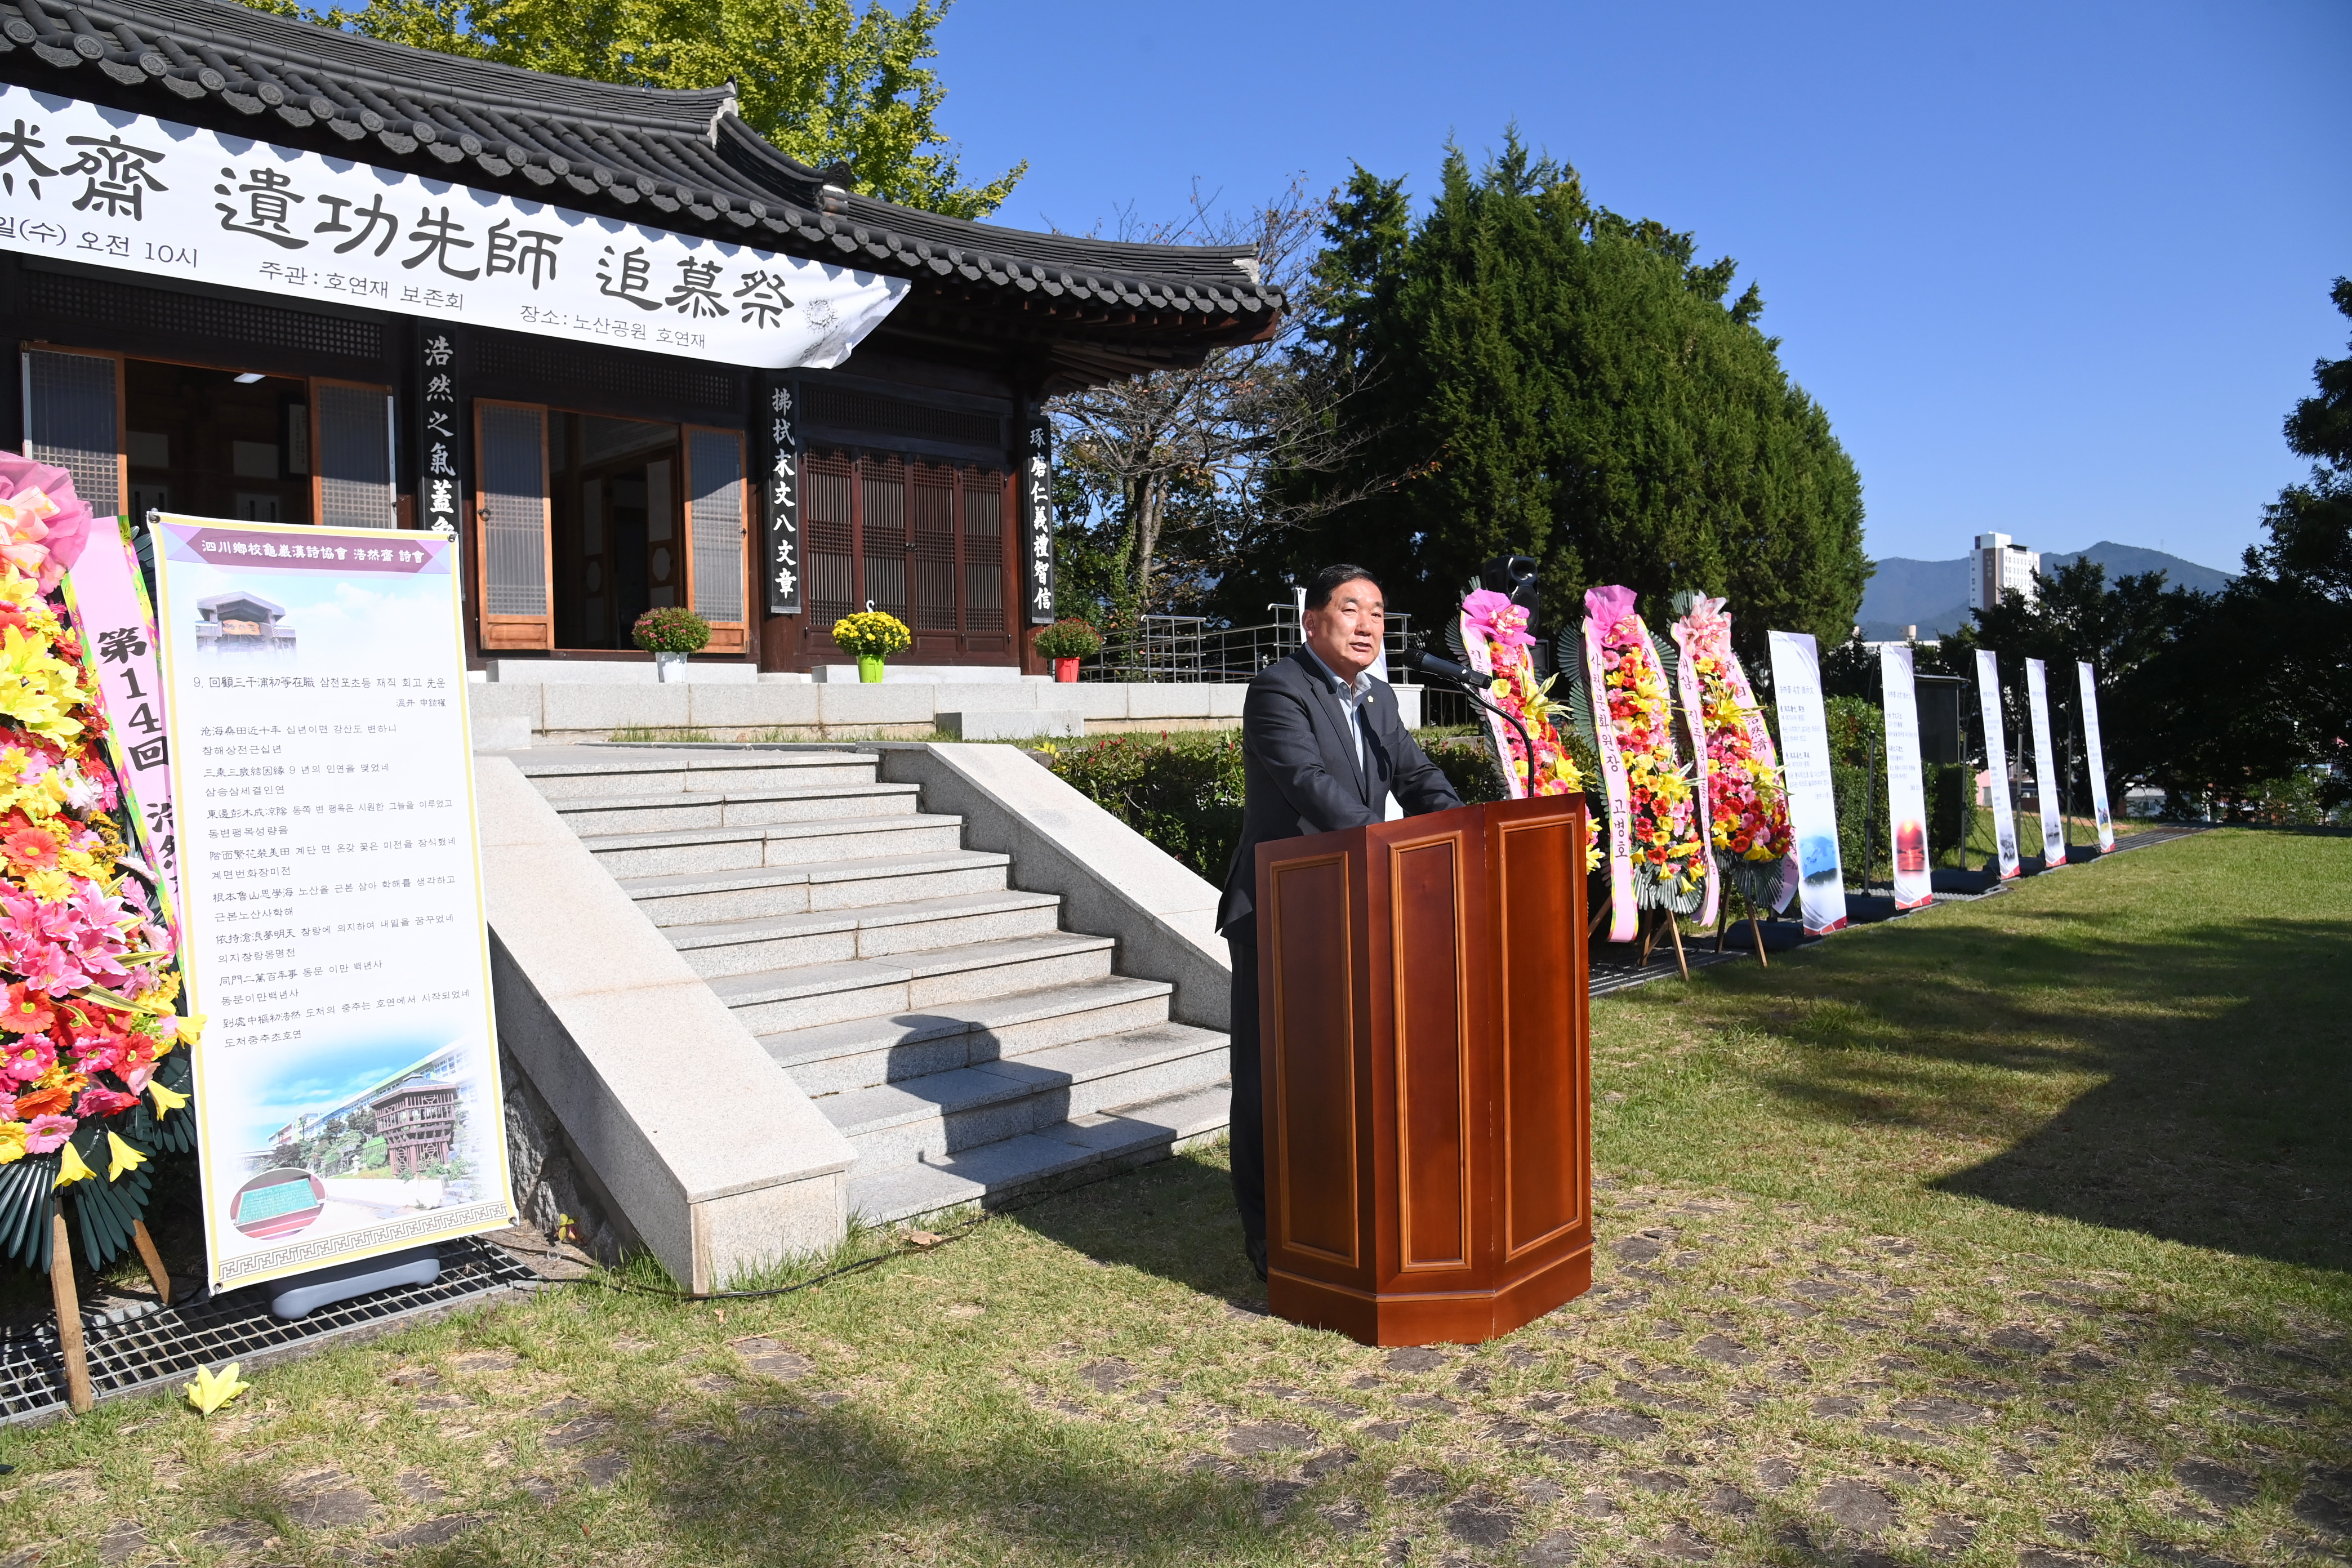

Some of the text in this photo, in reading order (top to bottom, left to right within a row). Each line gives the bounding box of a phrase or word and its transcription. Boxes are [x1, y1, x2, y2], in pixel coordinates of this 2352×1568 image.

[215, 167, 563, 291] 遺功先師
[595, 245, 795, 330] 追慕祭
[76, 231, 130, 257] 오전
[145, 242, 197, 268] 10시
[399, 284, 464, 311] 보존회
[656, 327, 705, 350] 호연재
[1029, 427, 1052, 611] 琢磨仁義禮智信
[353, 548, 394, 562] 浩然齋
[398, 550, 425, 564] 詩會
[193, 676, 203, 688] 9.
[320, 677, 372, 688] 삼천포초등
[376, 678, 396, 688] 재직
[402, 678, 422, 688] 회고
[286, 725, 328, 734] 십년이면
[333, 725, 363, 734] 강산도
[367, 724, 397, 733] 변하니
[202, 745, 282, 756] 창해상전근십년
[1590, 652, 1628, 858] 사천문화원장 고병호
[289, 765, 296, 774] 9
[301, 765, 320, 774] 년의
[327, 764, 355, 773] 인연을
[360, 763, 389, 773] 맺었네
[205, 785, 284, 797] 삼승삼세결인연
[292, 805, 311, 816] 동쪽
[315, 805, 324, 814] 변
[328, 804, 354, 813] 팽목은
[358, 802, 384, 812] 시원한
[389, 801, 414, 810] 그늘을
[419, 799, 453, 808] 이루었고
[296, 845, 317, 855] 계단
[322, 844, 331, 854] 면
[336, 843, 355, 853] 온갖
[359, 842, 378, 852] 꽃은
[384, 840, 413, 849] 미전을
[418, 837, 456, 848] 장식했네
[211, 866, 291, 880] 계면번화장미전
[299, 885, 329, 896] 노산을
[334, 883, 354, 893] 근본
[358, 881, 377, 891] 삼아
[416, 876, 456, 887] 생각하고
[301, 925, 331, 937] 창랑에
[337, 921, 375, 933] 의지하여
[381, 917, 410, 928] 내일을
[415, 914, 453, 925] 꿈꾸었네
[218, 947, 295, 964] 의지창랑몽명천
[302, 966, 323, 977] 동문
[329, 964, 349, 974] 이만
[354, 959, 382, 970] 백년사
[221, 988, 299, 1006] 동문이만백년사
[306, 1005, 335, 1018] 도처의
[341, 1001, 371, 1013] 중추는
[376, 995, 416, 1008] 호연에서
[422, 988, 469, 1002] 시작되었네
[224, 1029, 301, 1048] 도처중추초호연
